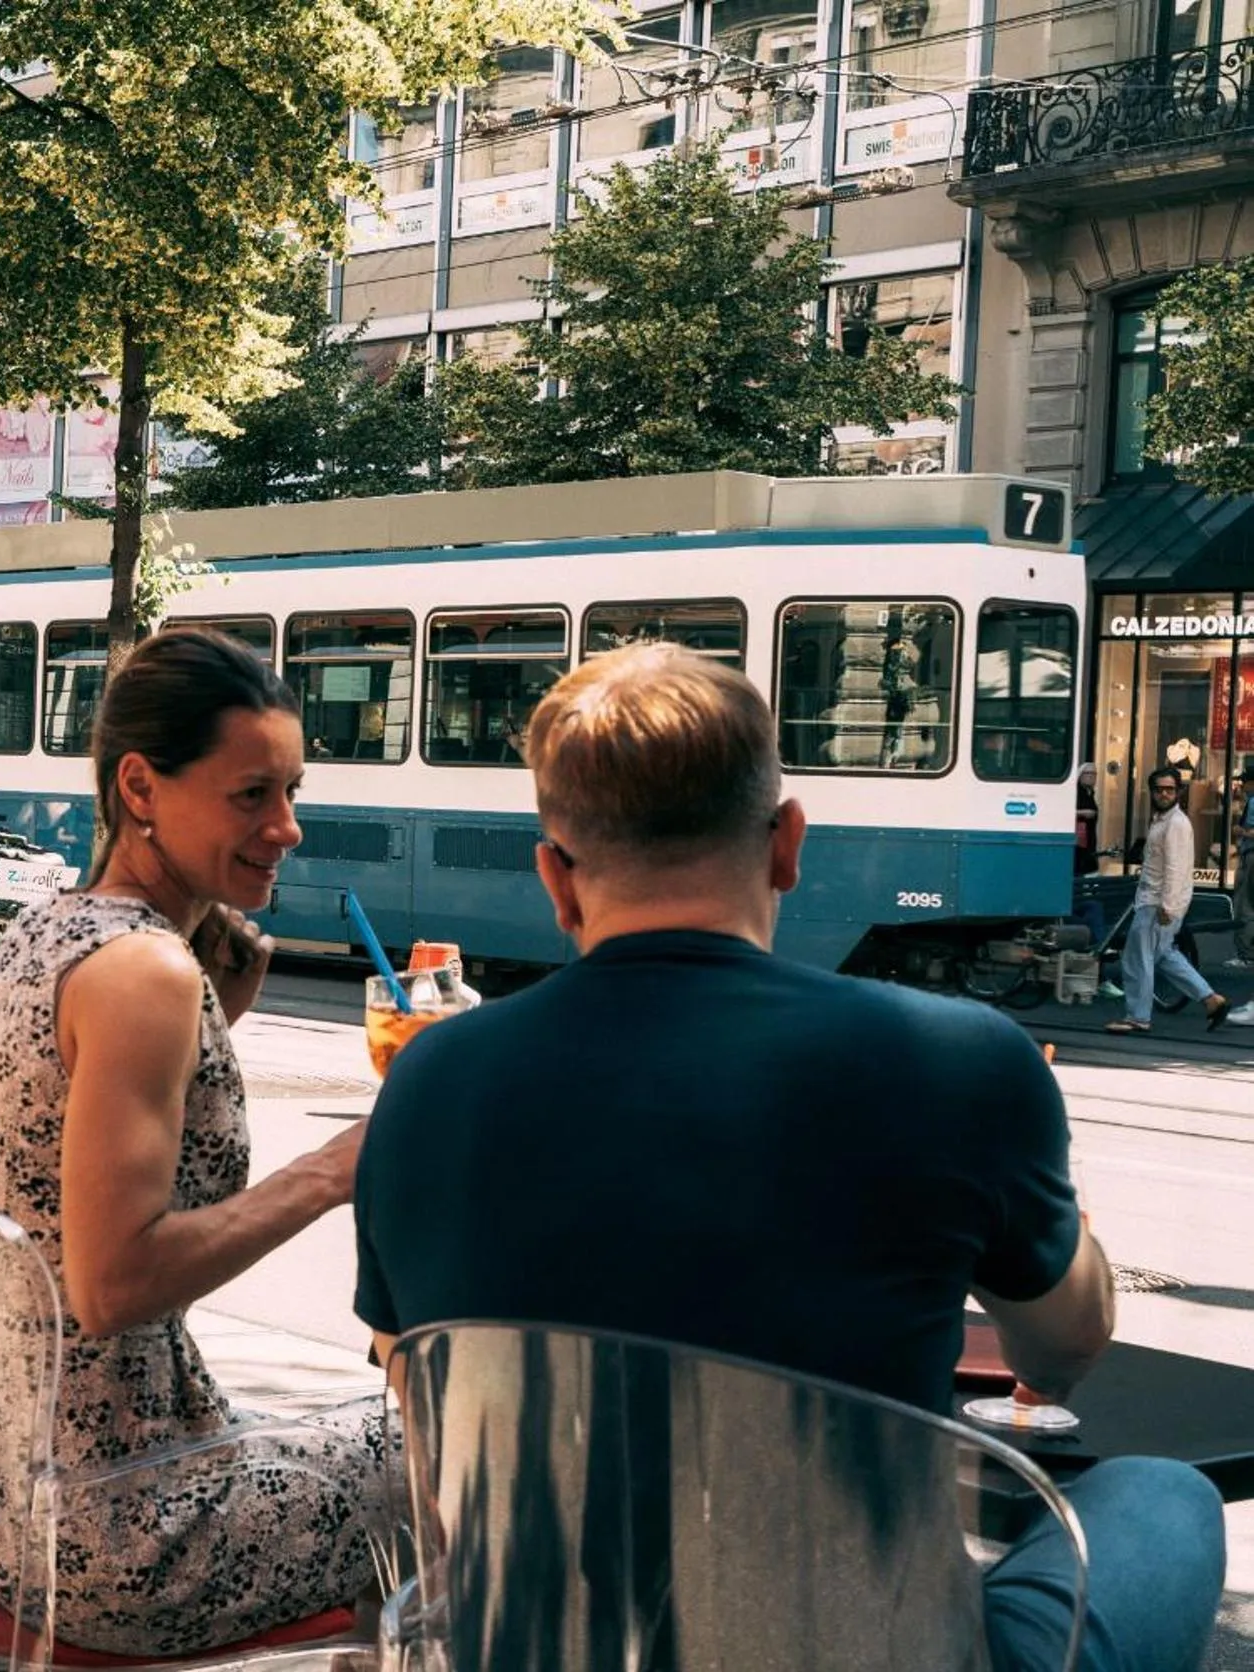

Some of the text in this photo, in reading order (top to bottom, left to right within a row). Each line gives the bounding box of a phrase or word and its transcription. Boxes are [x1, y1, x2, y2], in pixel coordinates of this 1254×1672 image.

[1022, 492, 1043, 535] 7
[1110, 614, 1254, 637] CALZEDONIA
[897, 891, 943, 908] 2095
